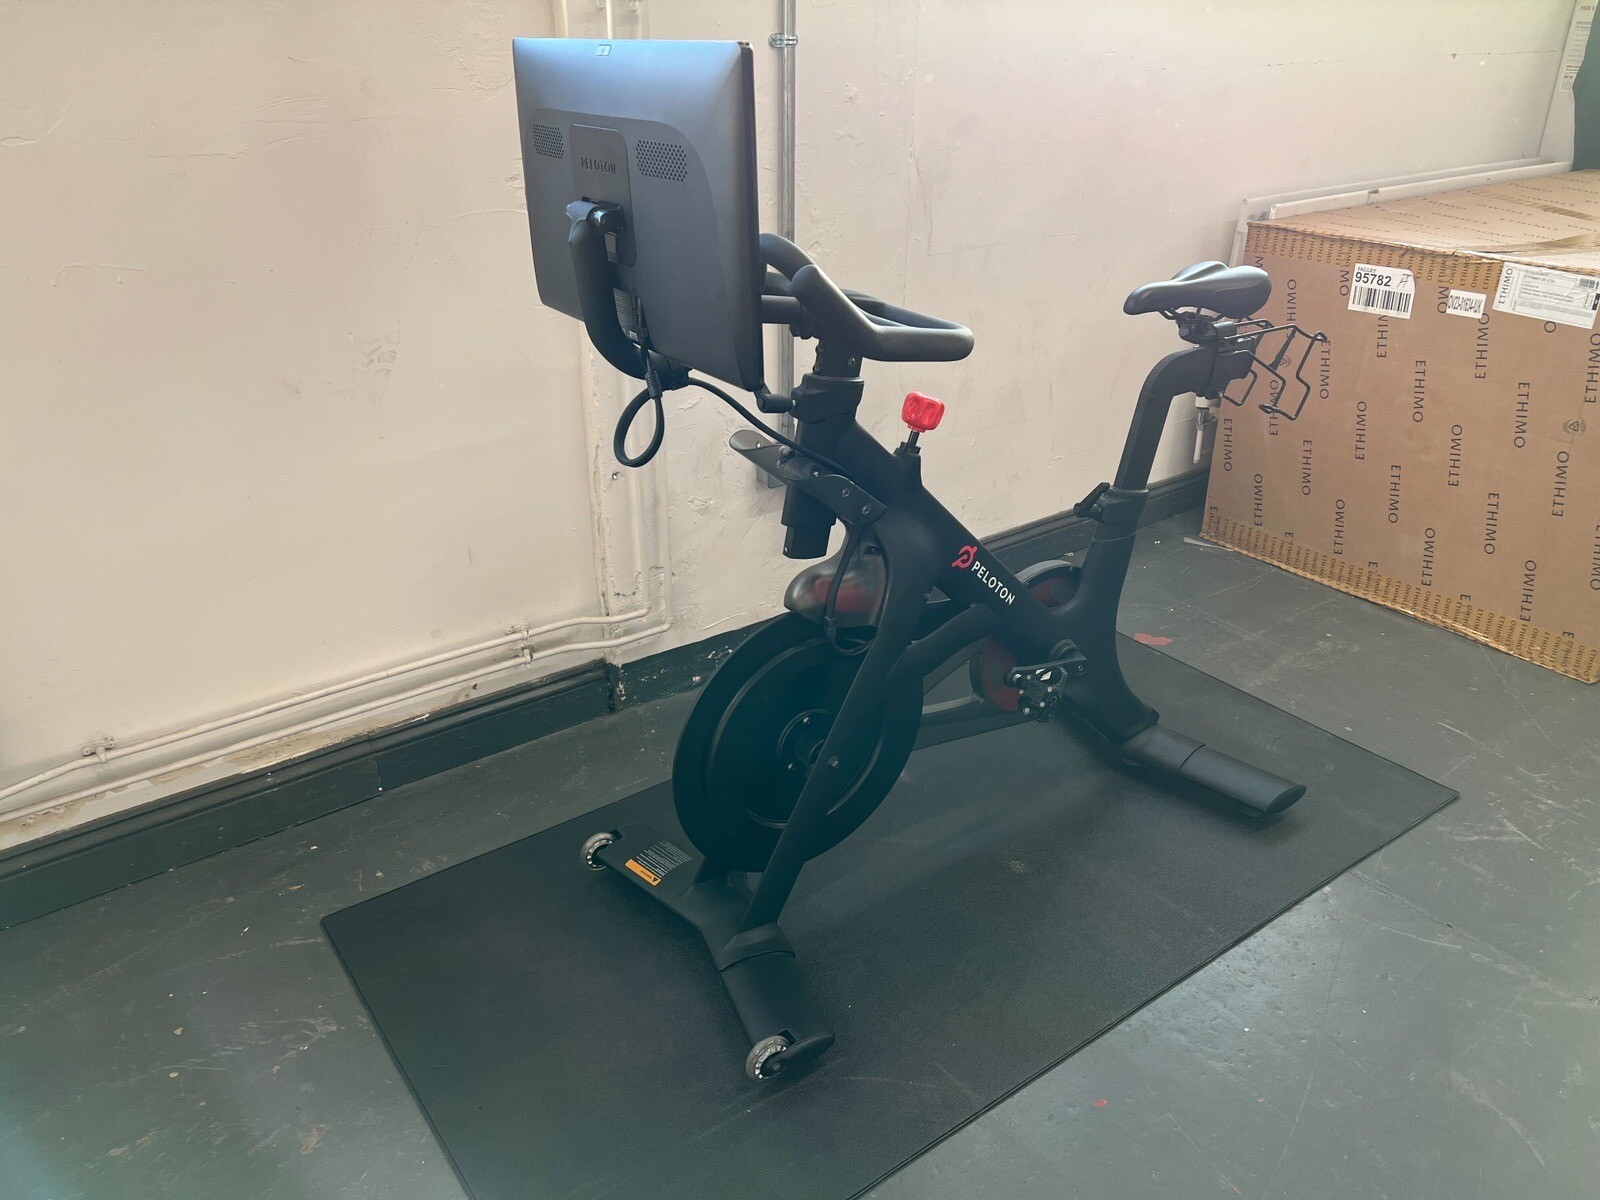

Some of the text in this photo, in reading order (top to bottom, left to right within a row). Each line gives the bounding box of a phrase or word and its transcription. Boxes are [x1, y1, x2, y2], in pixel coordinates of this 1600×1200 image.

[581, 156, 616, 174] PELOTON
[1355, 271, 1392, 287] 95782
[1498, 268, 1513, 304] ETHIMO
[1475, 313, 1490, 379] ETHIMO
[1584, 333, 1600, 403] ETHIMO
[1413, 360, 1426, 422] ETHIMO
[1514, 382, 1530, 448] ETHIMO
[1223, 418, 1232, 472] ETHIMO
[1355, 401, 1367, 460] ETHIMO
[1448, 424, 1463, 487] ETHIMO
[1302, 440, 1312, 495] ETHIMO
[1388, 464, 1401, 523] ETHIMO
[1552, 451, 1570, 517] ETHIMO
[1254, 473, 1263, 527] ETHIMO
[1334, 500, 1345, 555] ETHIMO
[1484, 492, 1500, 555] ETHIMO
[971, 560, 1015, 605] PELOTON
[1421, 528, 1436, 587] ETHIMO
[1520, 560, 1537, 622] ETHIMO
